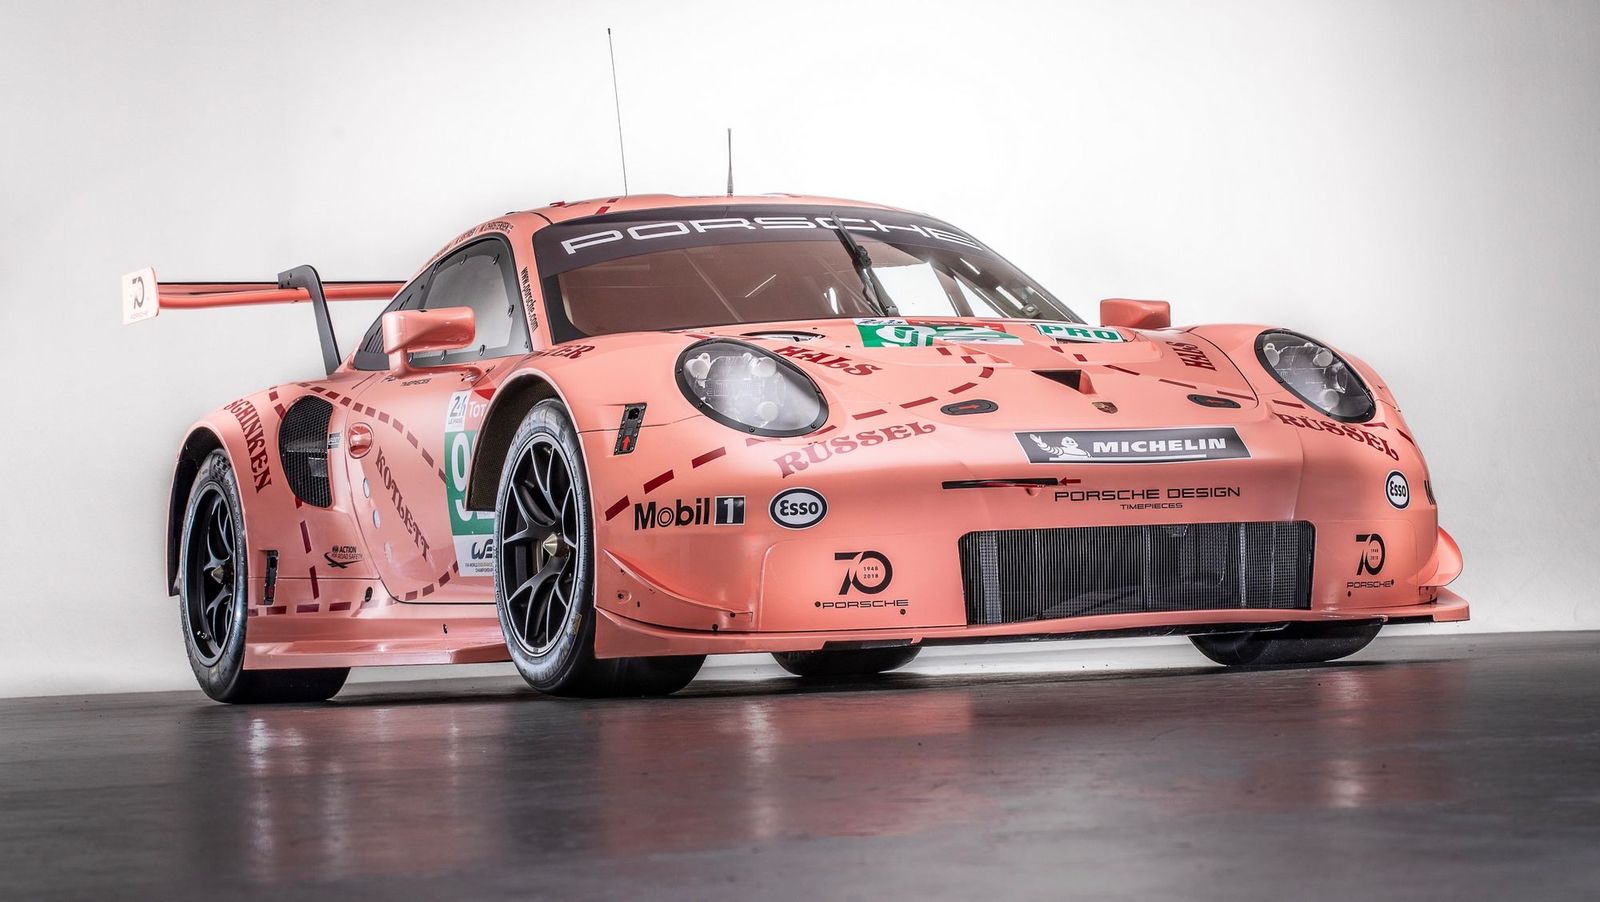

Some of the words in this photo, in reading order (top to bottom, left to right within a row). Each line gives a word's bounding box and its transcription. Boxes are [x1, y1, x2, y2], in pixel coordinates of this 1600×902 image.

[561, 217, 984, 255] PORSCHE
[520, 266, 539, 333] www.porsche.com
[1040, 325, 1118, 341] PRO
[772, 346, 883, 376] HALS
[224, 399, 272, 493] SCHINKEN
[773, 421, 936, 478] RÜSSEL
[1093, 438, 1226, 453] MICHELIN
[1272, 412, 1399, 461] RÜSSEL
[376, 445, 430, 562] KOTLETT
[1055, 488, 1160, 502] PORSCHE
[1167, 487, 1240, 499] DESIGN
[1389, 480, 1407, 497] Esso
[634, 497, 711, 531] Mobil
[779, 500, 819, 516] Esso
[1120, 502, 1183, 510] TIMEPIECES
[1356, 533, 1386, 576] 70
[834, 550, 893, 596] 70
[1347, 580, 1391, 589] PORSCHE
[822, 599, 909, 609] PORSCHE
